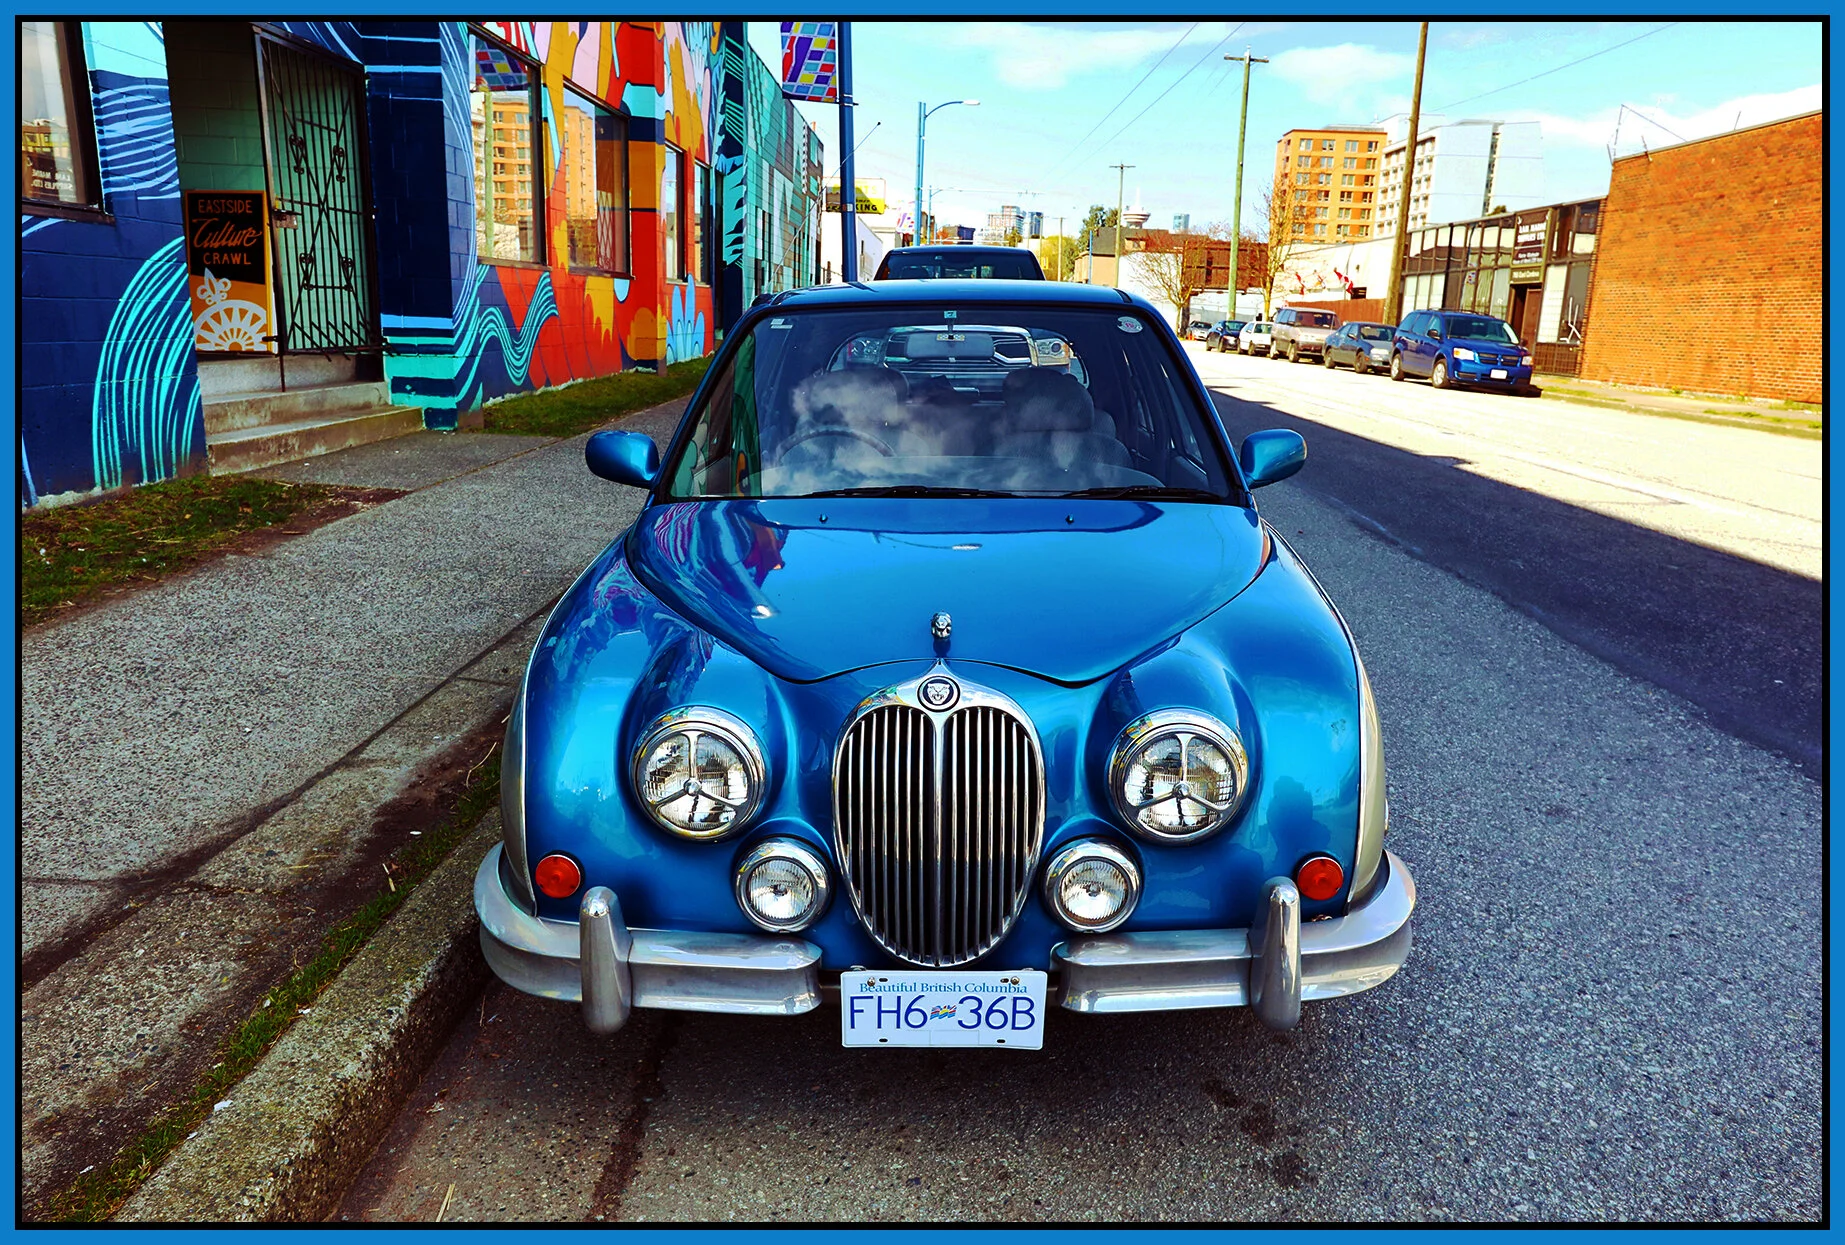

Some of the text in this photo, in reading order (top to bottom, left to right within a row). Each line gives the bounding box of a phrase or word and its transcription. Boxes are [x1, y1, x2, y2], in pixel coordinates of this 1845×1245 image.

[198, 199, 253, 213] EASTSIDE
[192, 217, 262, 248] Culture
[203, 252, 252, 265] CRAWL
[860, 982, 1027, 993] Beautiful British Columbia
[849, 994, 1035, 1030] FH6 36B
